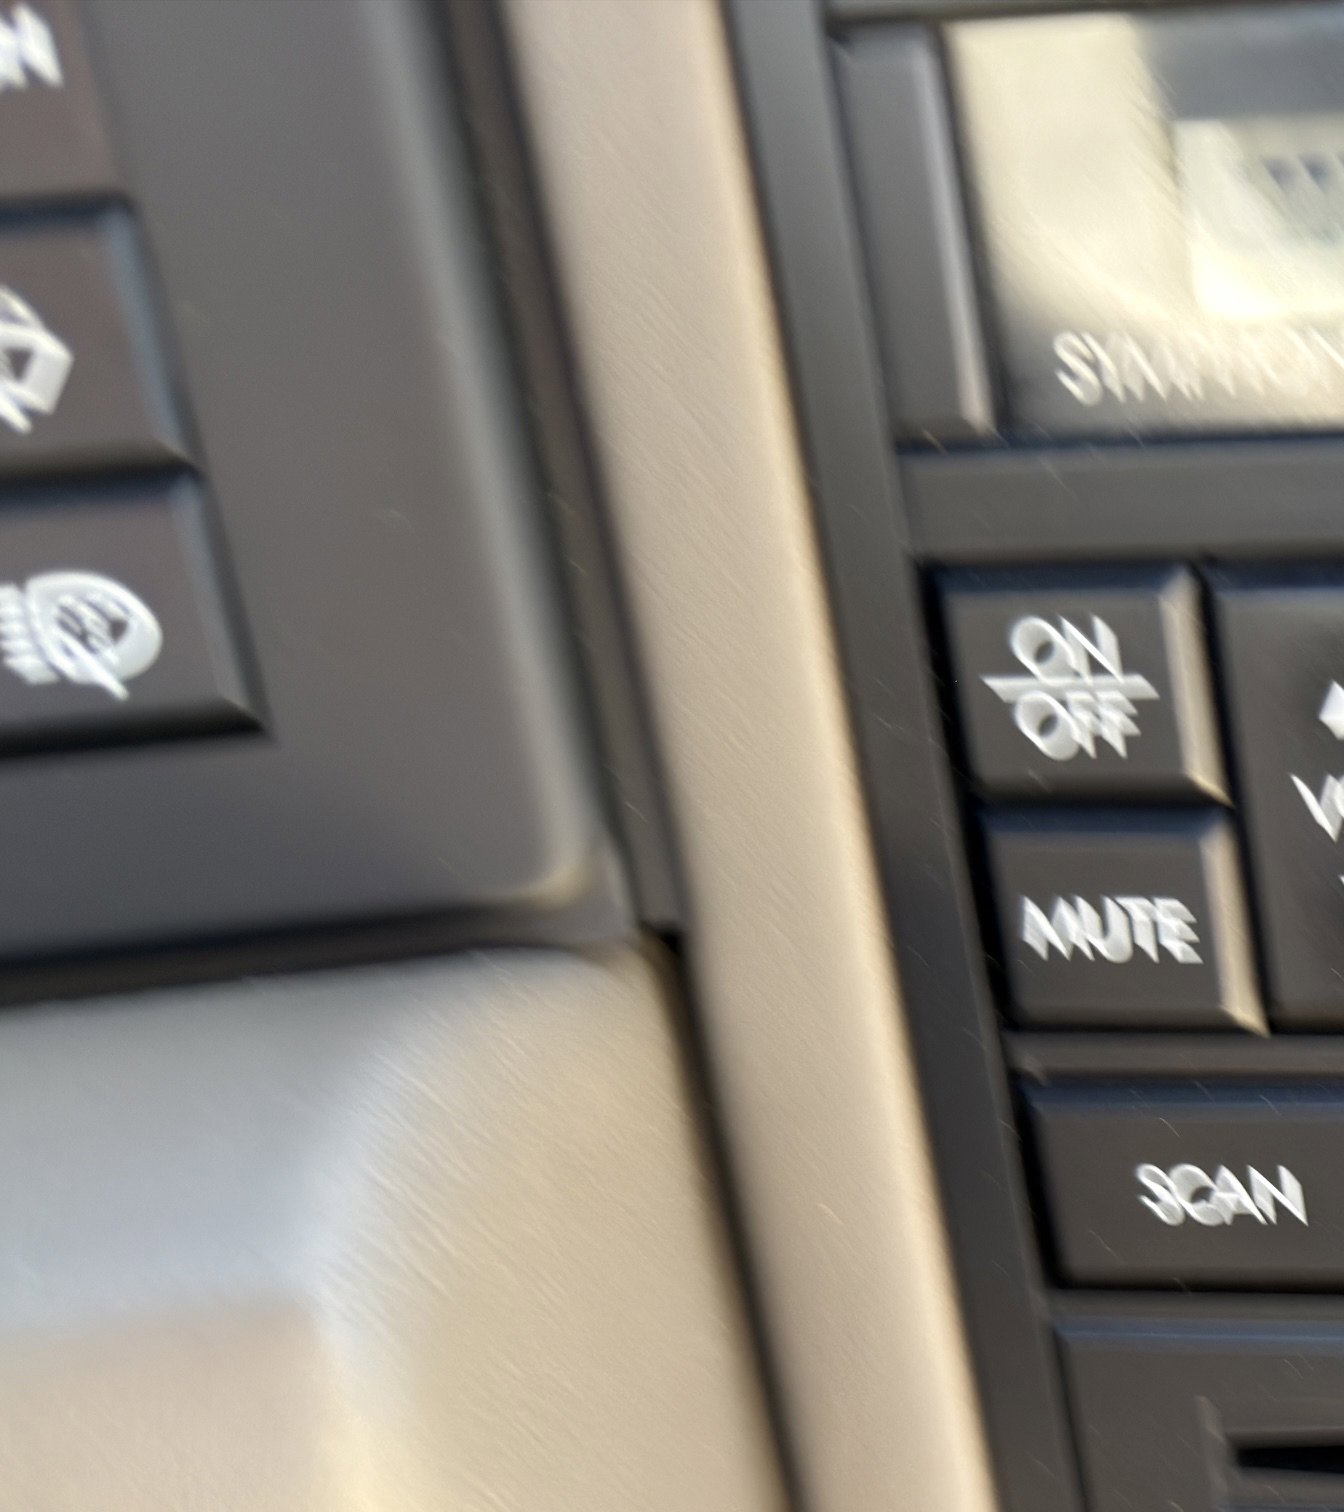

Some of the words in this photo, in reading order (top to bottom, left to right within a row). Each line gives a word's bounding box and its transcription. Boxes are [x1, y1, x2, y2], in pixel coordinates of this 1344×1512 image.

[1010, 614, 1124, 684] ON
[1013, 688, 1140, 762] OFF
[1020, 894, 1204, 964] MUTE
[1135, 1162, 1308, 1227] SCAN
